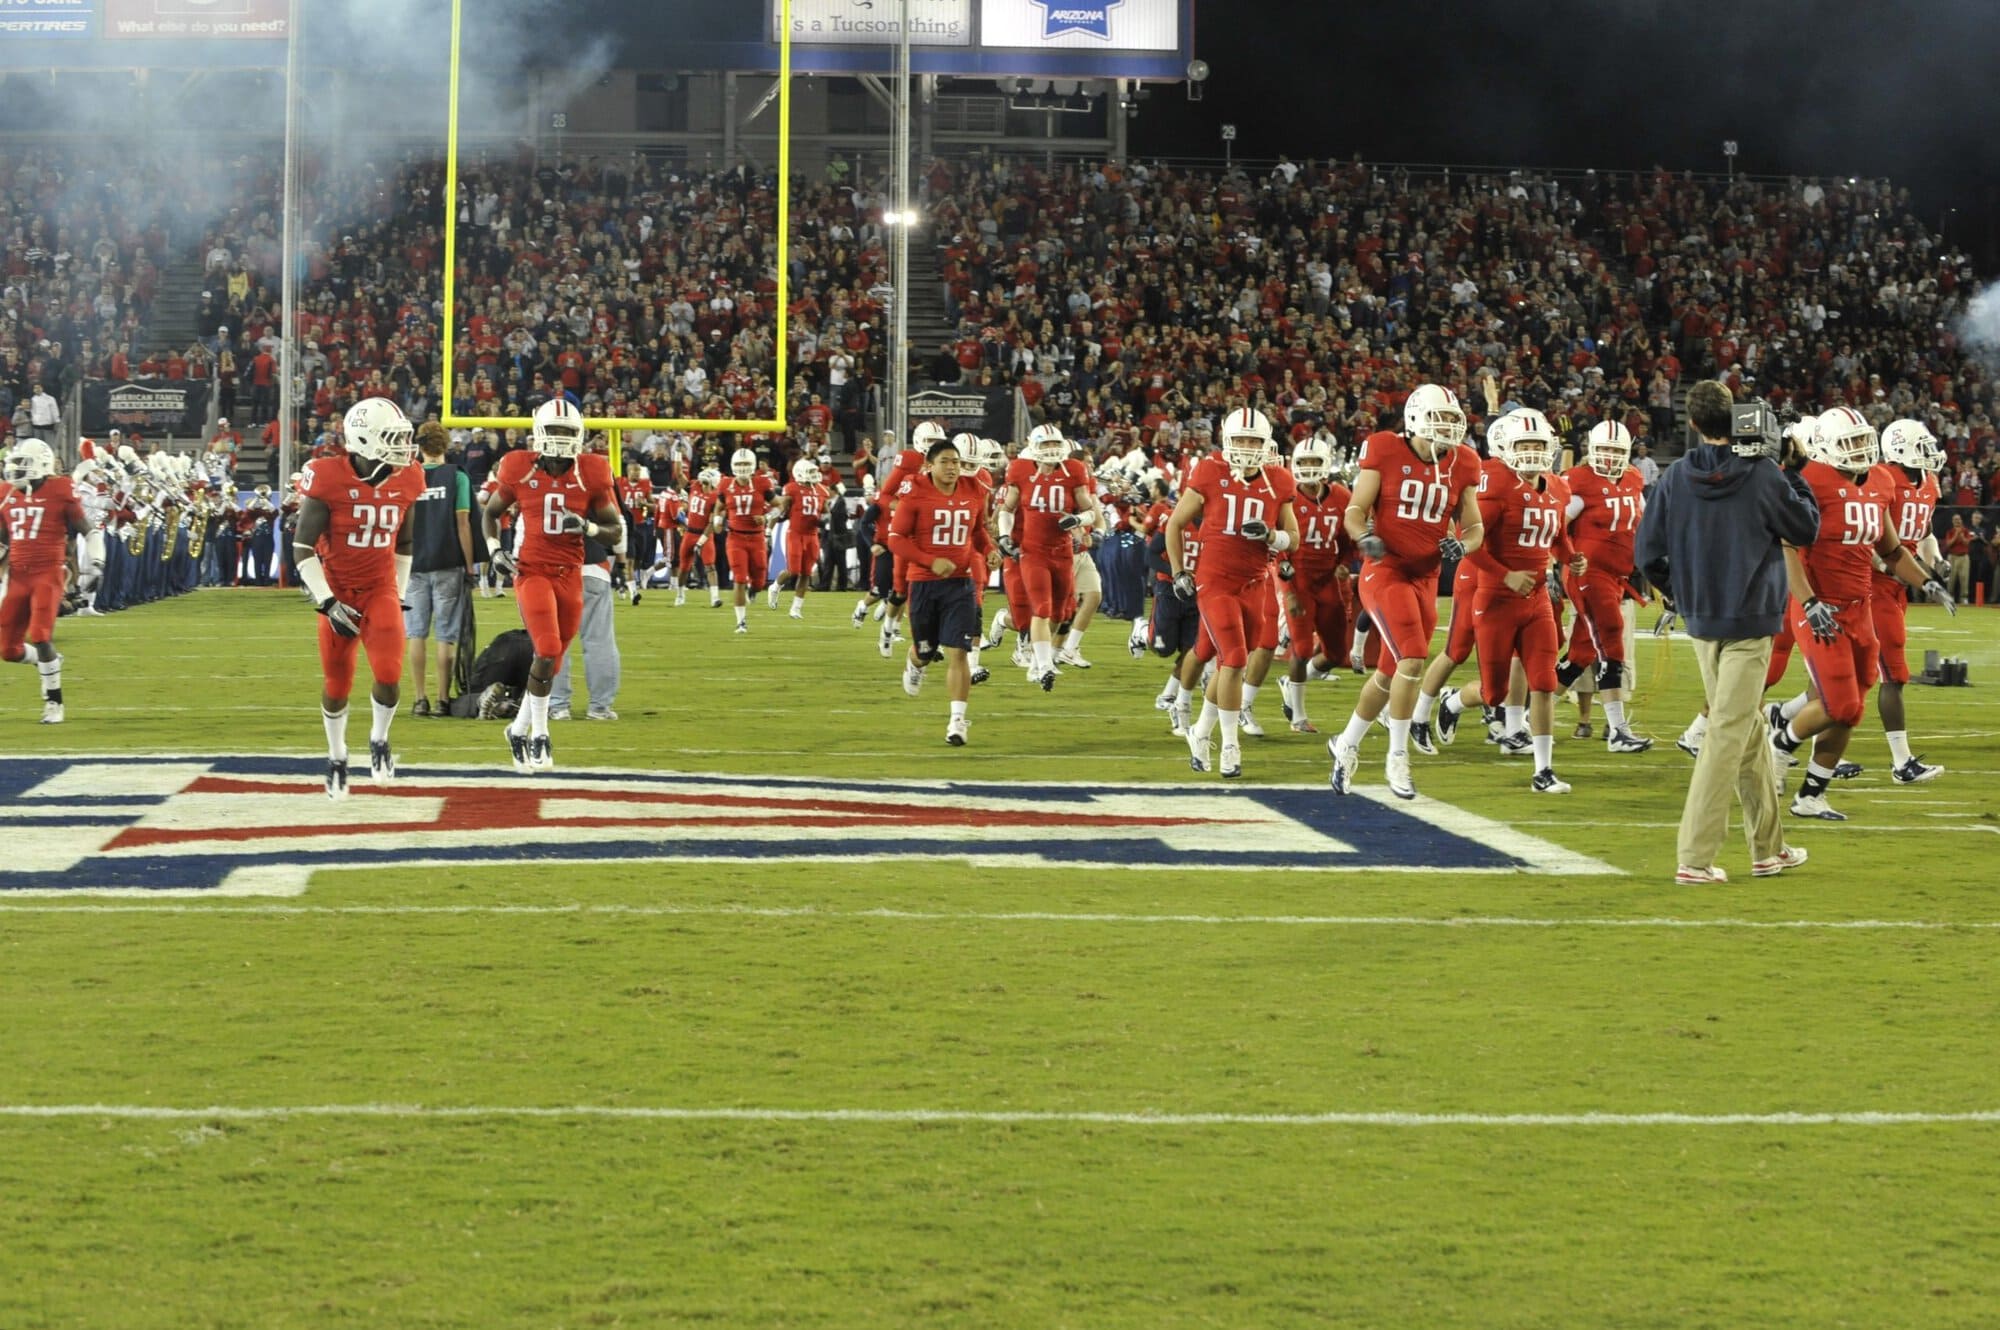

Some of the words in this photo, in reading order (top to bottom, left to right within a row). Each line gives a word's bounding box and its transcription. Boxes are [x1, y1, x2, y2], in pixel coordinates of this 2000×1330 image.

[117, 21, 154, 33] What
[158, 21, 186, 33] else
[191, 21, 209, 33] do
[212, 22, 238, 34] you
[241, 20, 286, 32] need?
[811, 19, 823, 32] a
[830, 15, 900, 33] Tucson
[1049, 9, 1105, 21] ARIZONA
[1723, 140, 1738, 155] 30
[110, 393, 153, 401] AMERICAN
[155, 393, 184, 401] FAMILY
[910, 399, 954, 407] AMERICAN
[955, 399, 985, 408] FAMILY
[543, 493, 565, 535] 6
[733, 495, 753, 516] 17
[1030, 485, 1065, 513] 40
[1397, 479, 1448, 524] 90
[9, 507, 45, 540] 27
[347, 504, 399, 548] 39
[932, 509, 970, 546] 26
[1305, 515, 1338, 549] 47
[1518, 508, 1558, 548] 50
[1842, 501, 1880, 545] 98
[1899, 502, 1930, 541] 83
